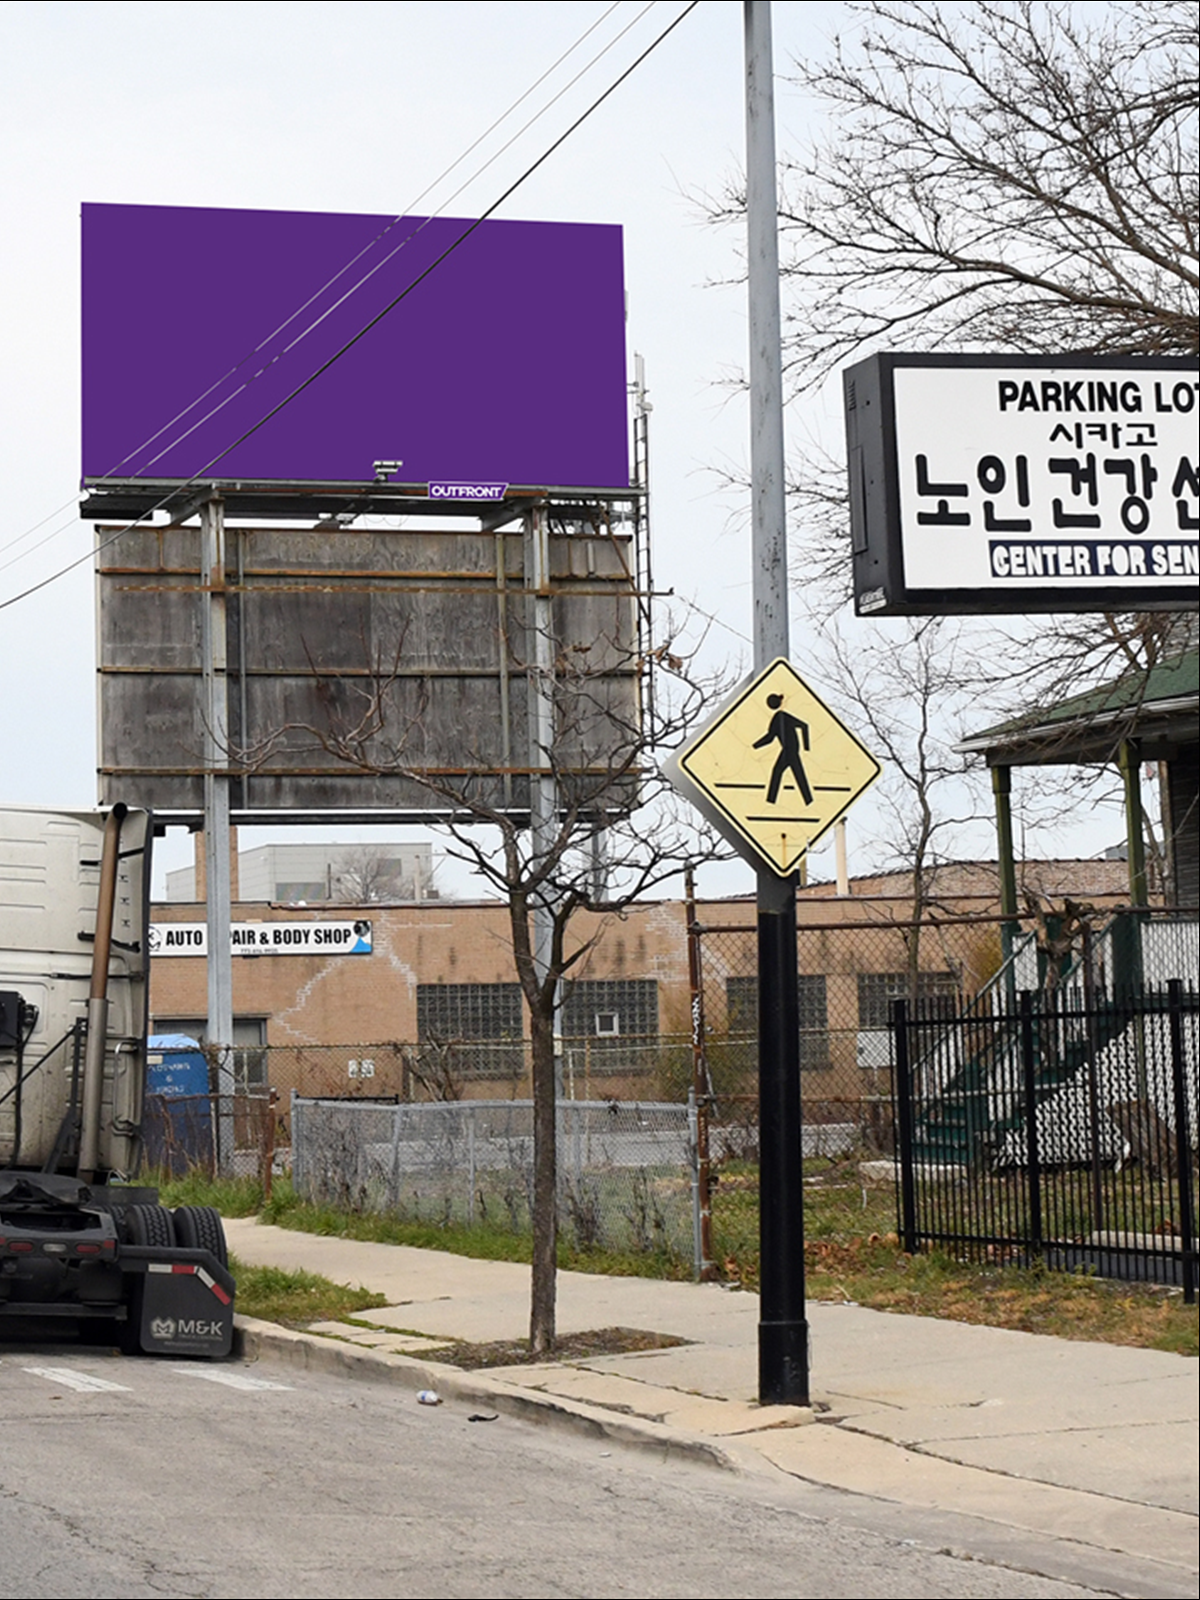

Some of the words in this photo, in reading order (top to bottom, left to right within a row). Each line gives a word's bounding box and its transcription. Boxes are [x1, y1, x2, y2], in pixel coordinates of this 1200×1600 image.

[998, 380, 1142, 413] PARKING
[1049, 422, 1157, 449] 시카고
[431, 485, 502, 498] OUTFRONT
[992, 545, 1090, 576] CENTER
[1096, 545, 1147, 575] FOR
[1151, 545, 1199, 575] SEN
[165, 930, 203, 946] AUTO
[230, 929, 256, 945] AIR
[259, 931, 270, 945] &
[273, 929, 311, 945] BODY
[313, 928, 352, 945] SHOP
[178, 1319, 223, 1336] M&K
